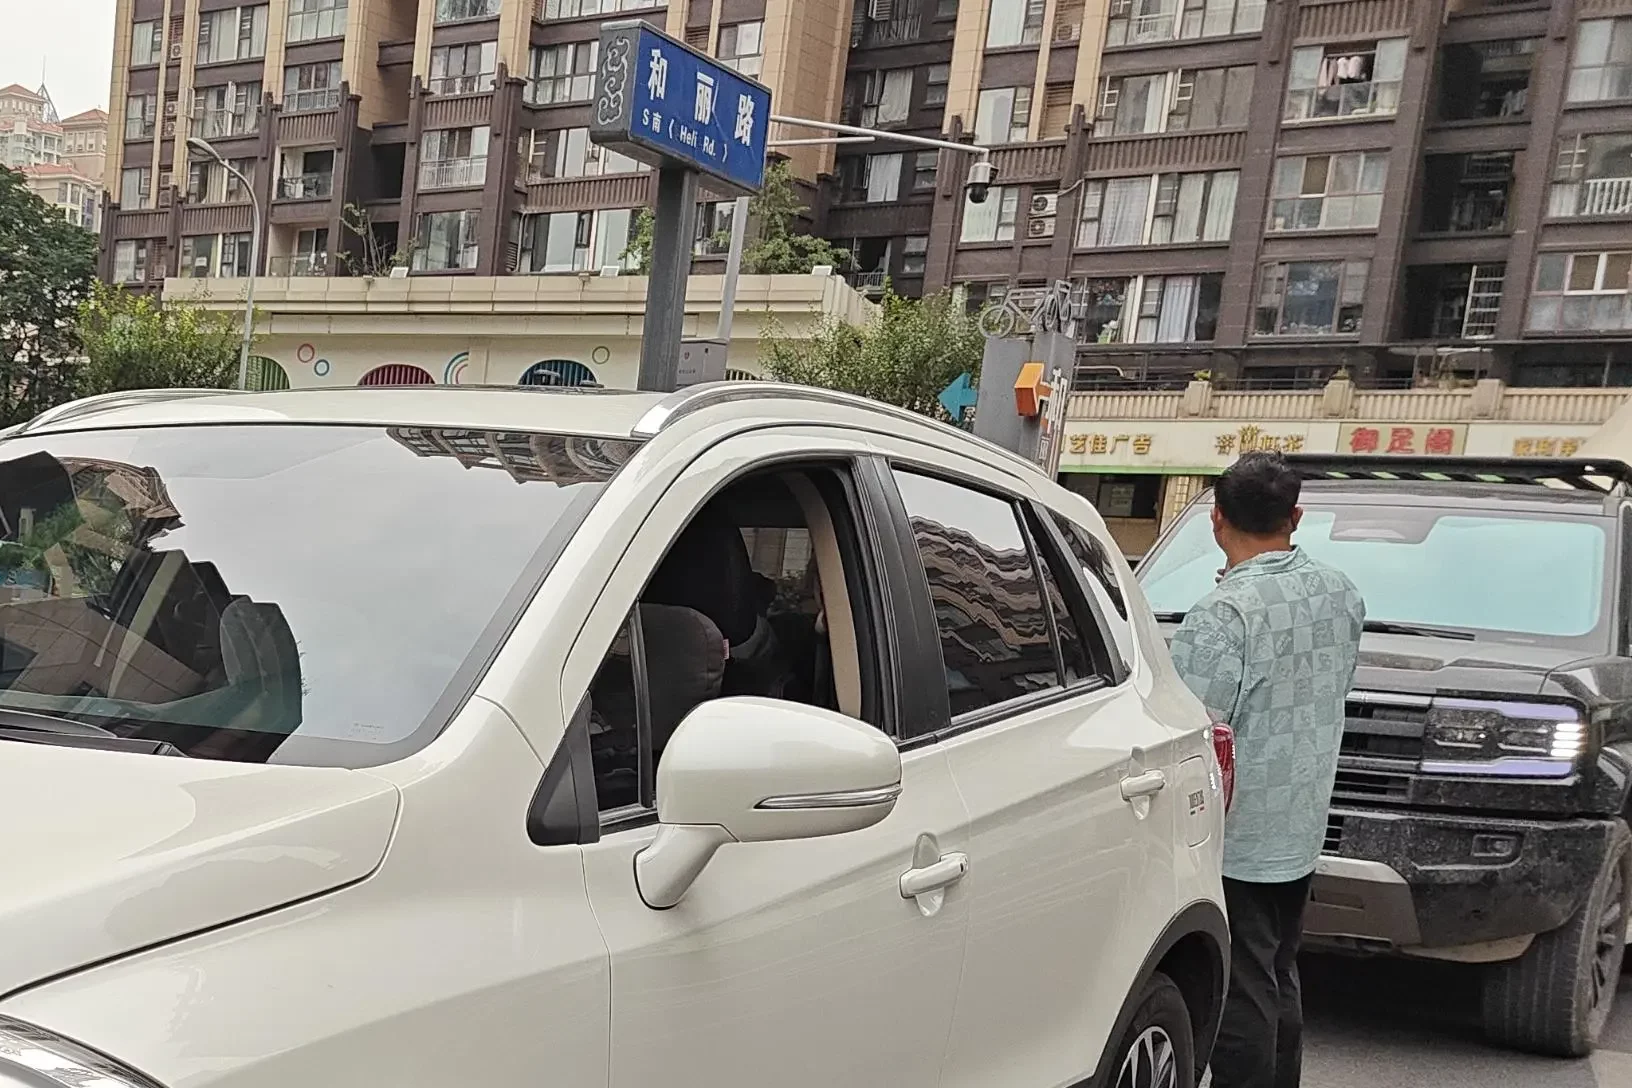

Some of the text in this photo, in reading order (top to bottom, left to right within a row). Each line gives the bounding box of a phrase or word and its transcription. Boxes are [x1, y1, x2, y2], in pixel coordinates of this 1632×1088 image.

[647, 48, 755, 147] 和丽路
[1061, 433, 1152, 456] 艺佳广告
